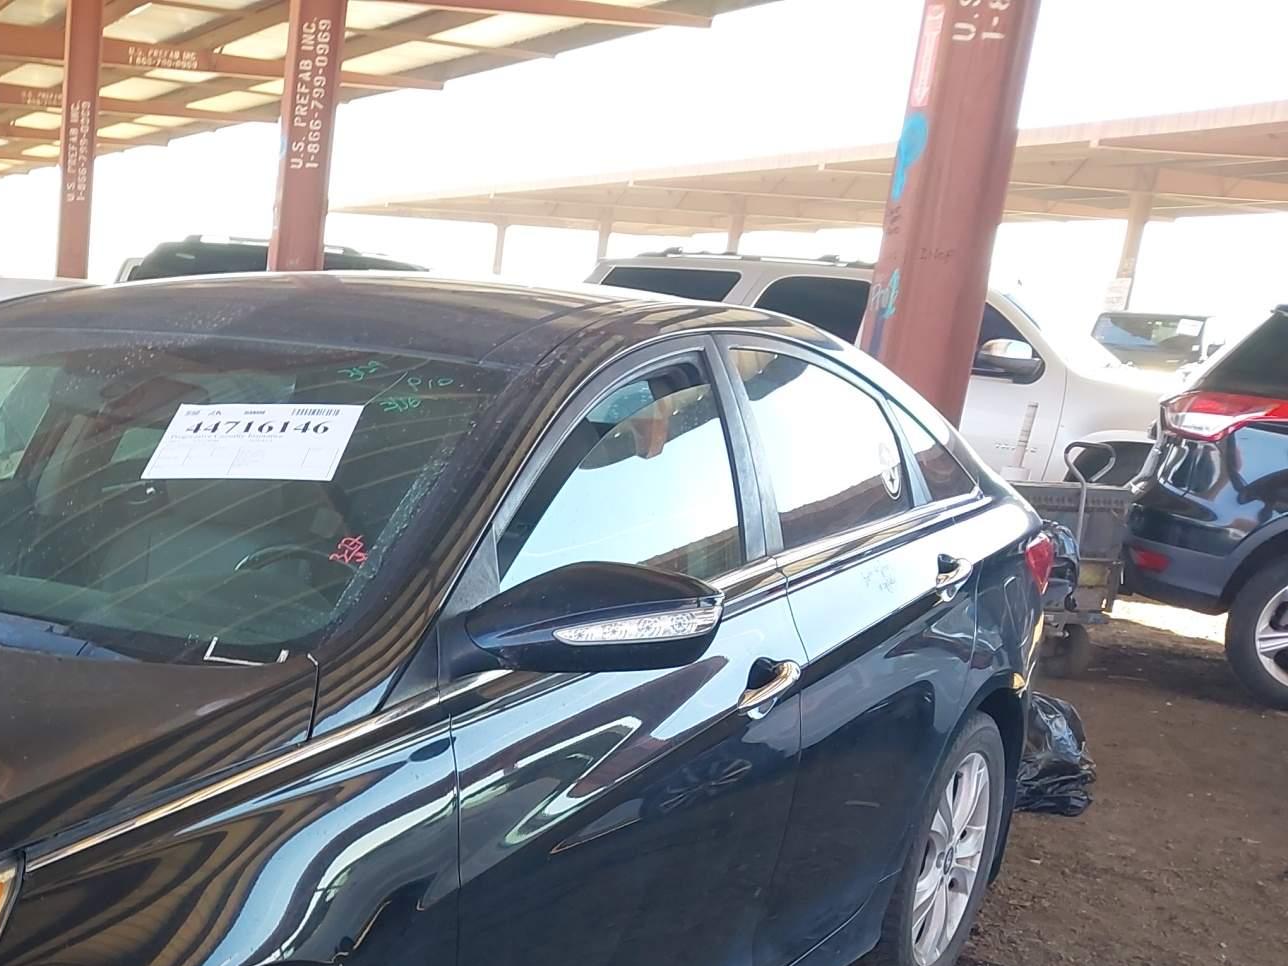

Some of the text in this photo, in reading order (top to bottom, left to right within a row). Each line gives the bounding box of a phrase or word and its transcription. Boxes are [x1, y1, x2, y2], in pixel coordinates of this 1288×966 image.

[290, 17, 317, 169] U.S. PREFAB INC.
[305, 19, 332, 169] 1-866-799-0969
[185, 420, 331, 434] 44716146
